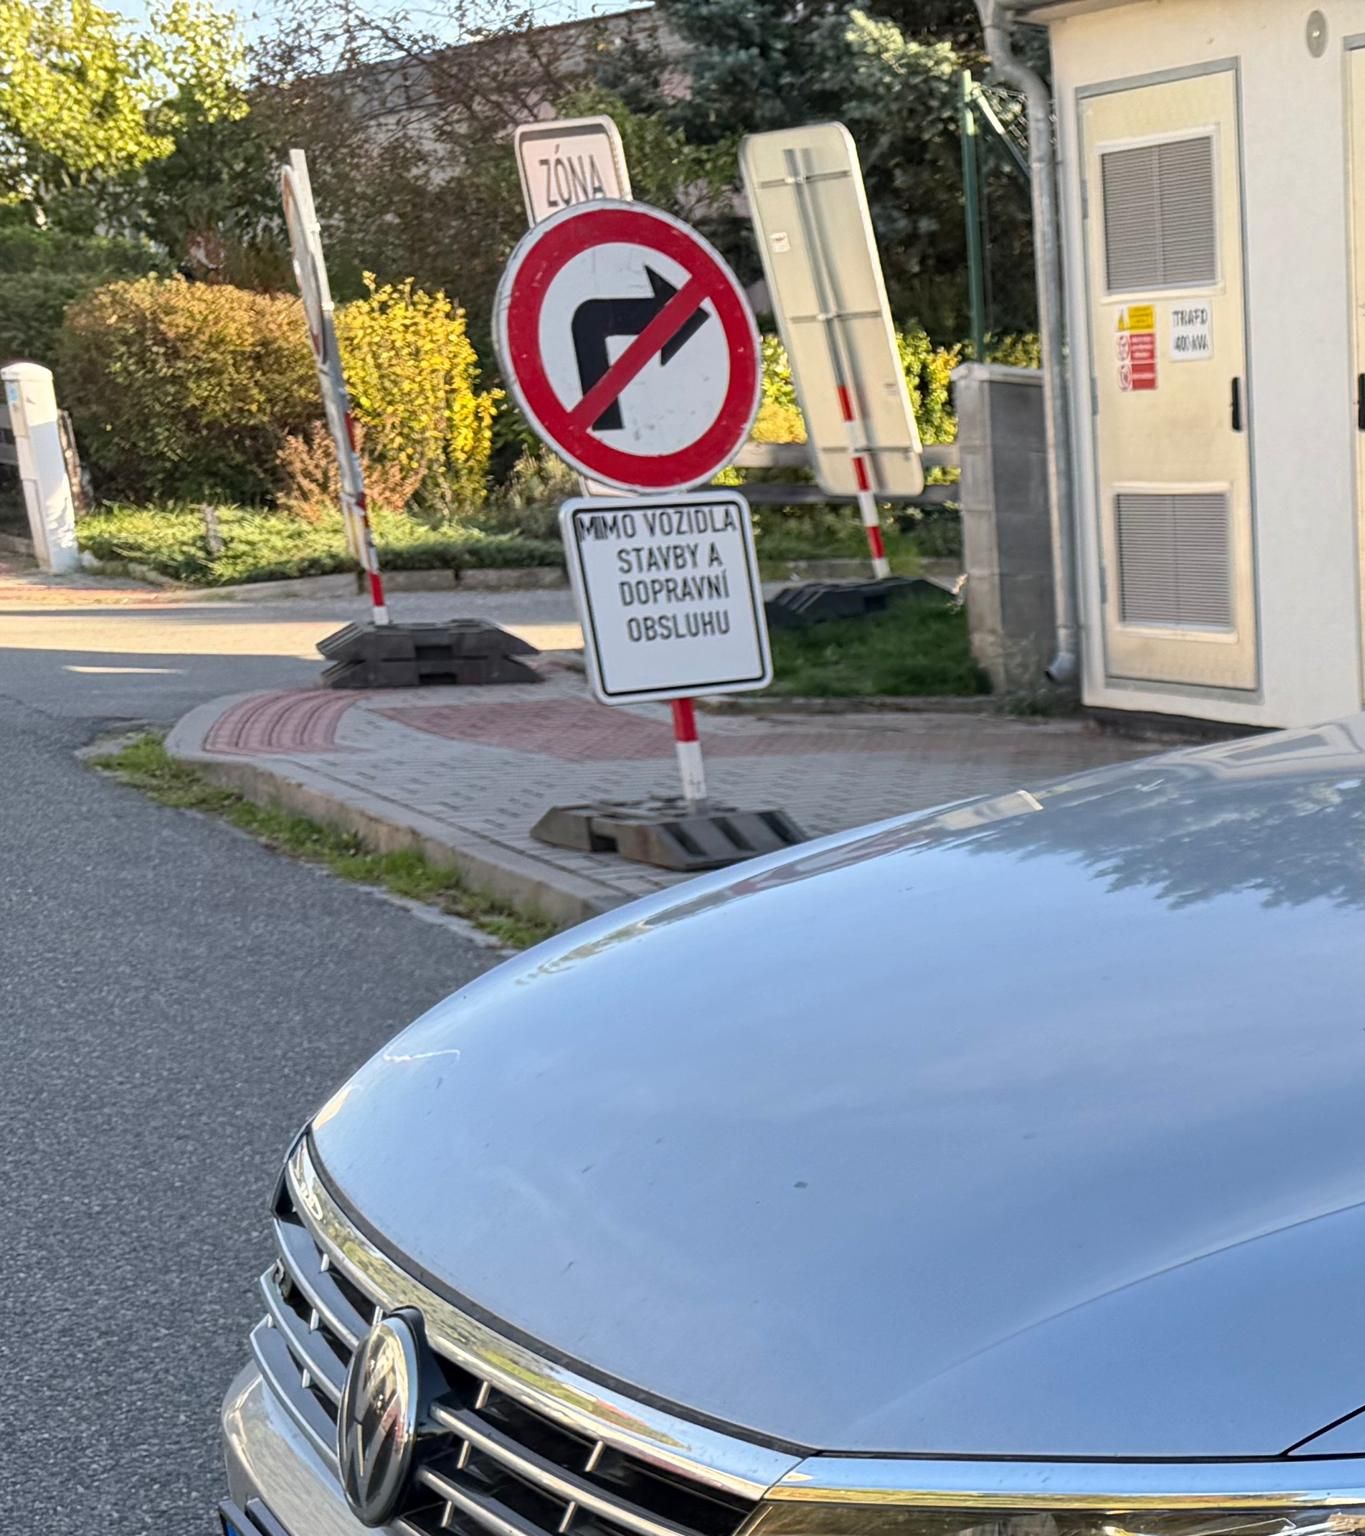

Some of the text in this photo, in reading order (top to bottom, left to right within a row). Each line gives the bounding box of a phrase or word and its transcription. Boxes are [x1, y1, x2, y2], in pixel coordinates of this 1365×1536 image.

[539, 143, 607, 208] ZÓNA
[576, 506, 738, 542] MIMO VOZIDLA
[617, 541, 724, 574] STAVBY A
[619, 569, 730, 607] DOPRAVNÍ
[627, 610, 731, 642] OBSLUHU
